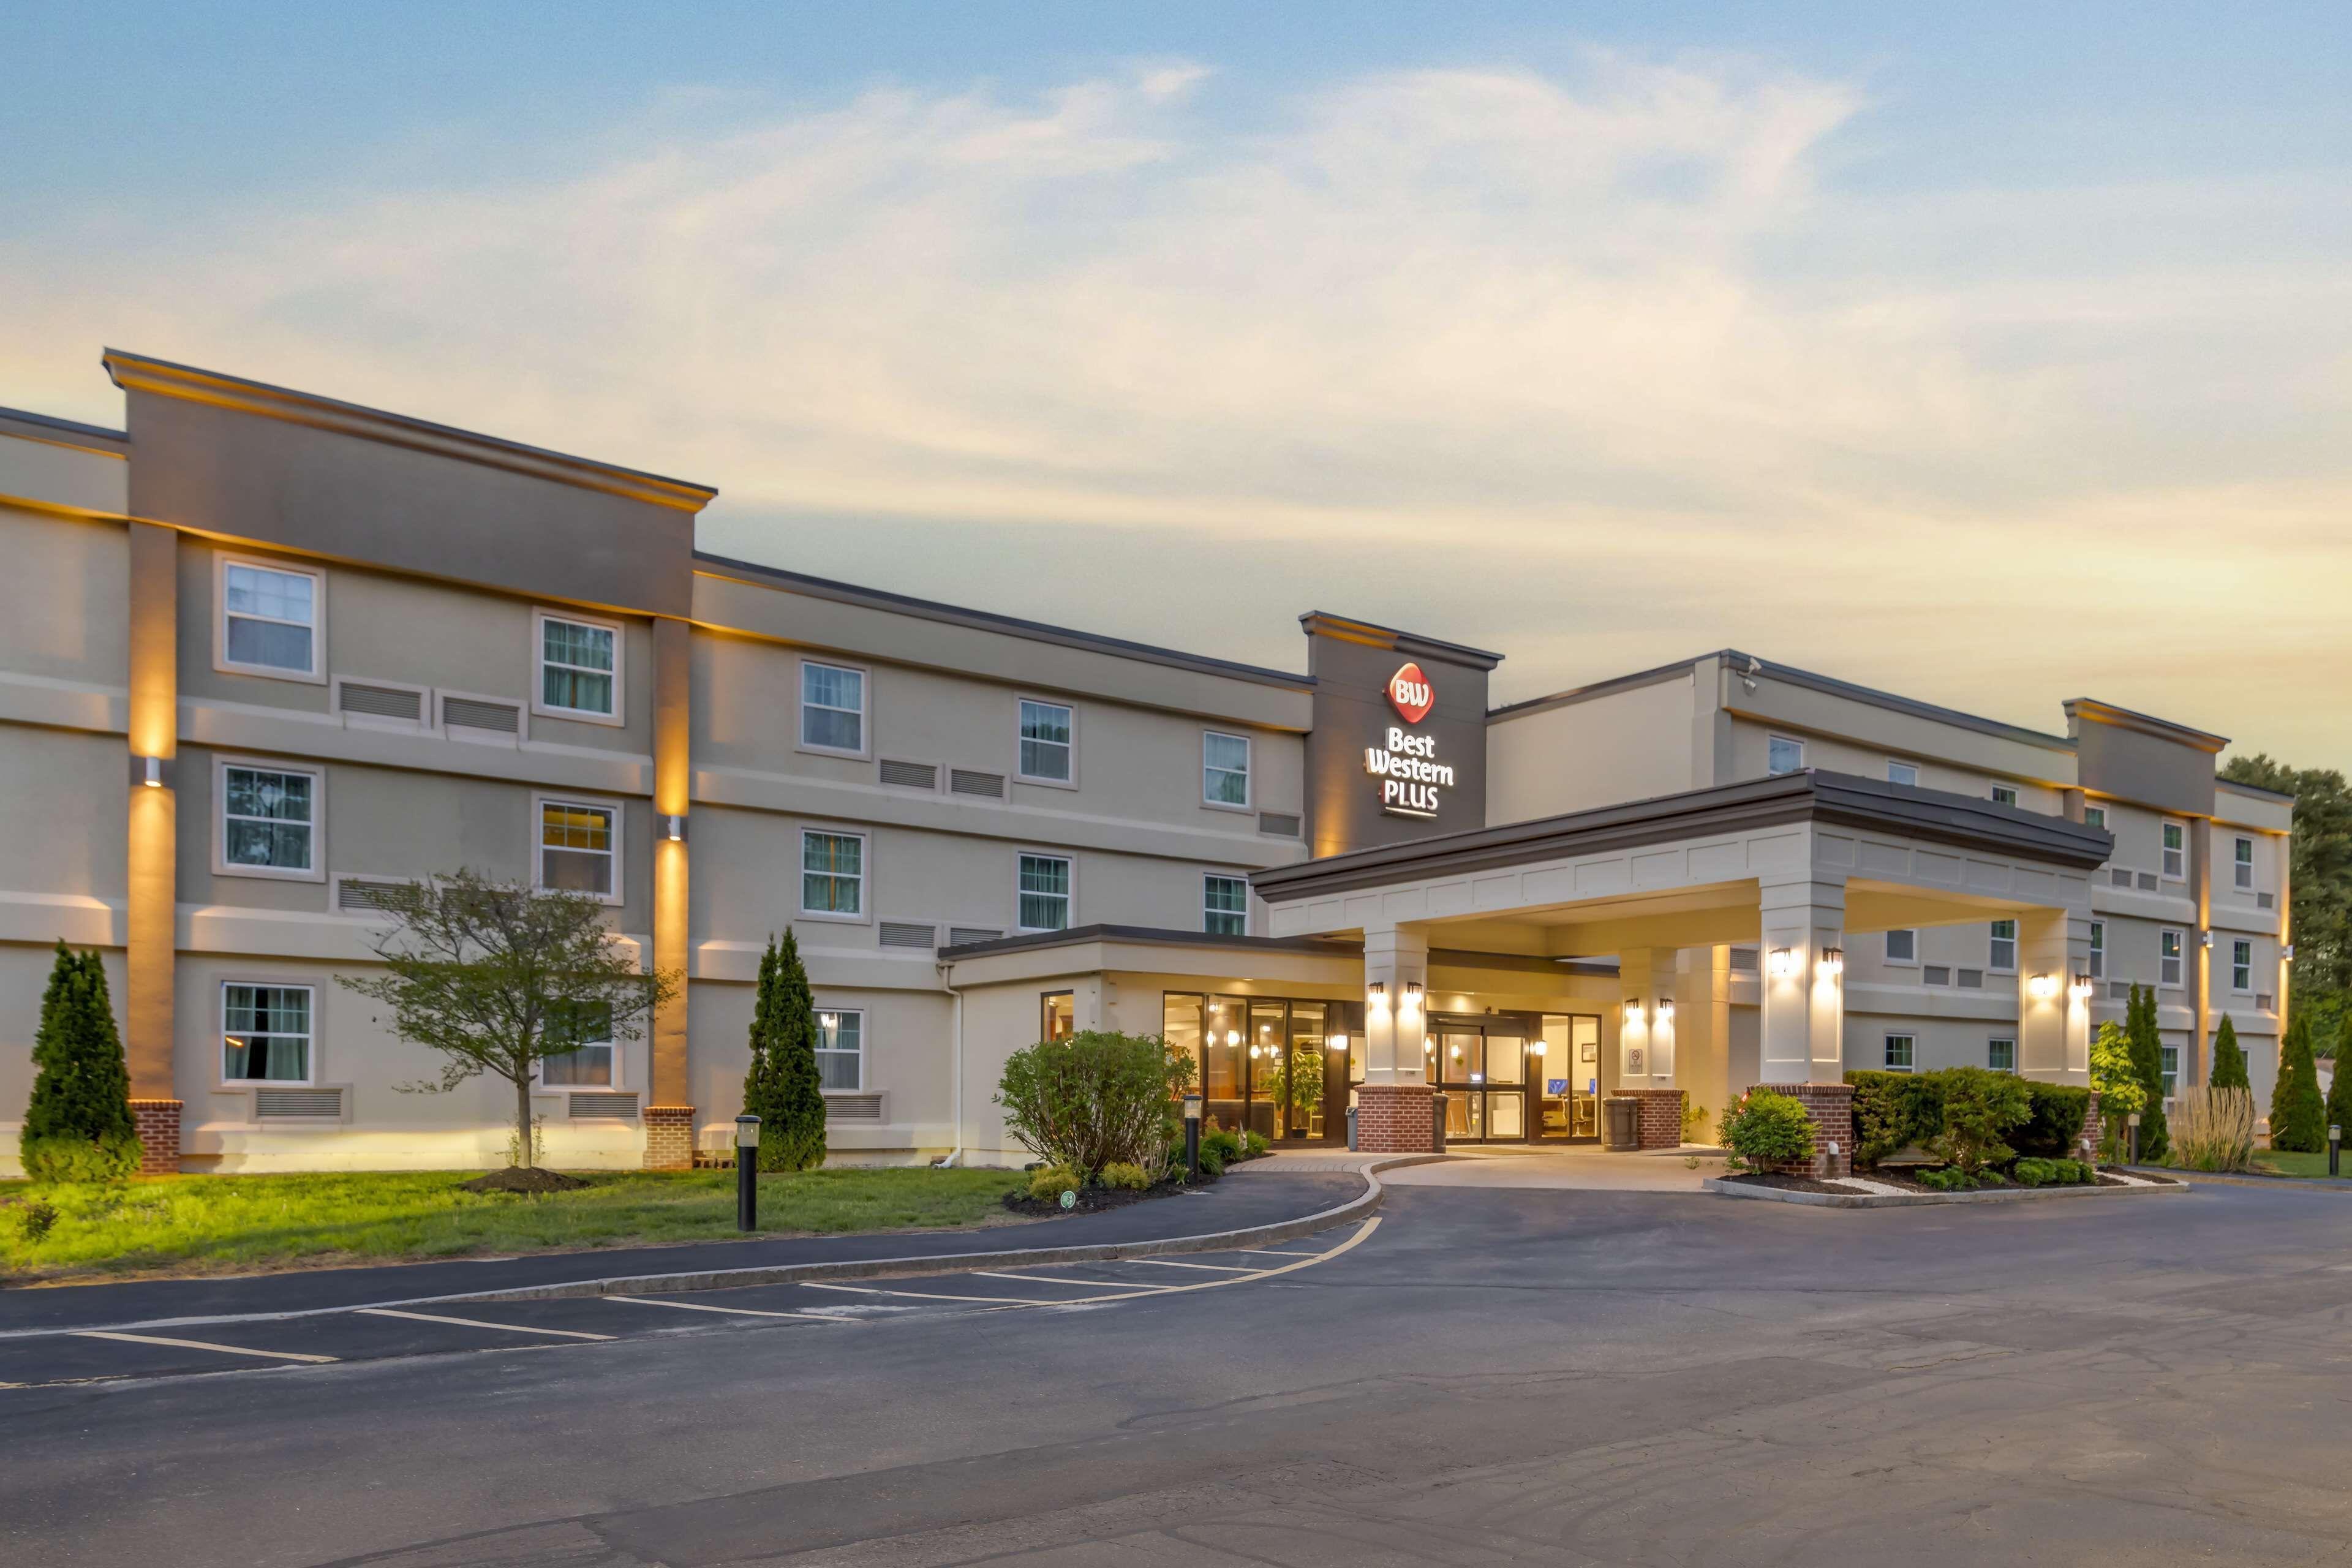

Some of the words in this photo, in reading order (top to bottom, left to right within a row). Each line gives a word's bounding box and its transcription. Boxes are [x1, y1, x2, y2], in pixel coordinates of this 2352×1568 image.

[1395, 679, 1429, 707] BW
[1387, 727, 1435, 759] Best
[1366, 747, 1454, 786] Western
[1384, 780, 1438, 810] PLUS
